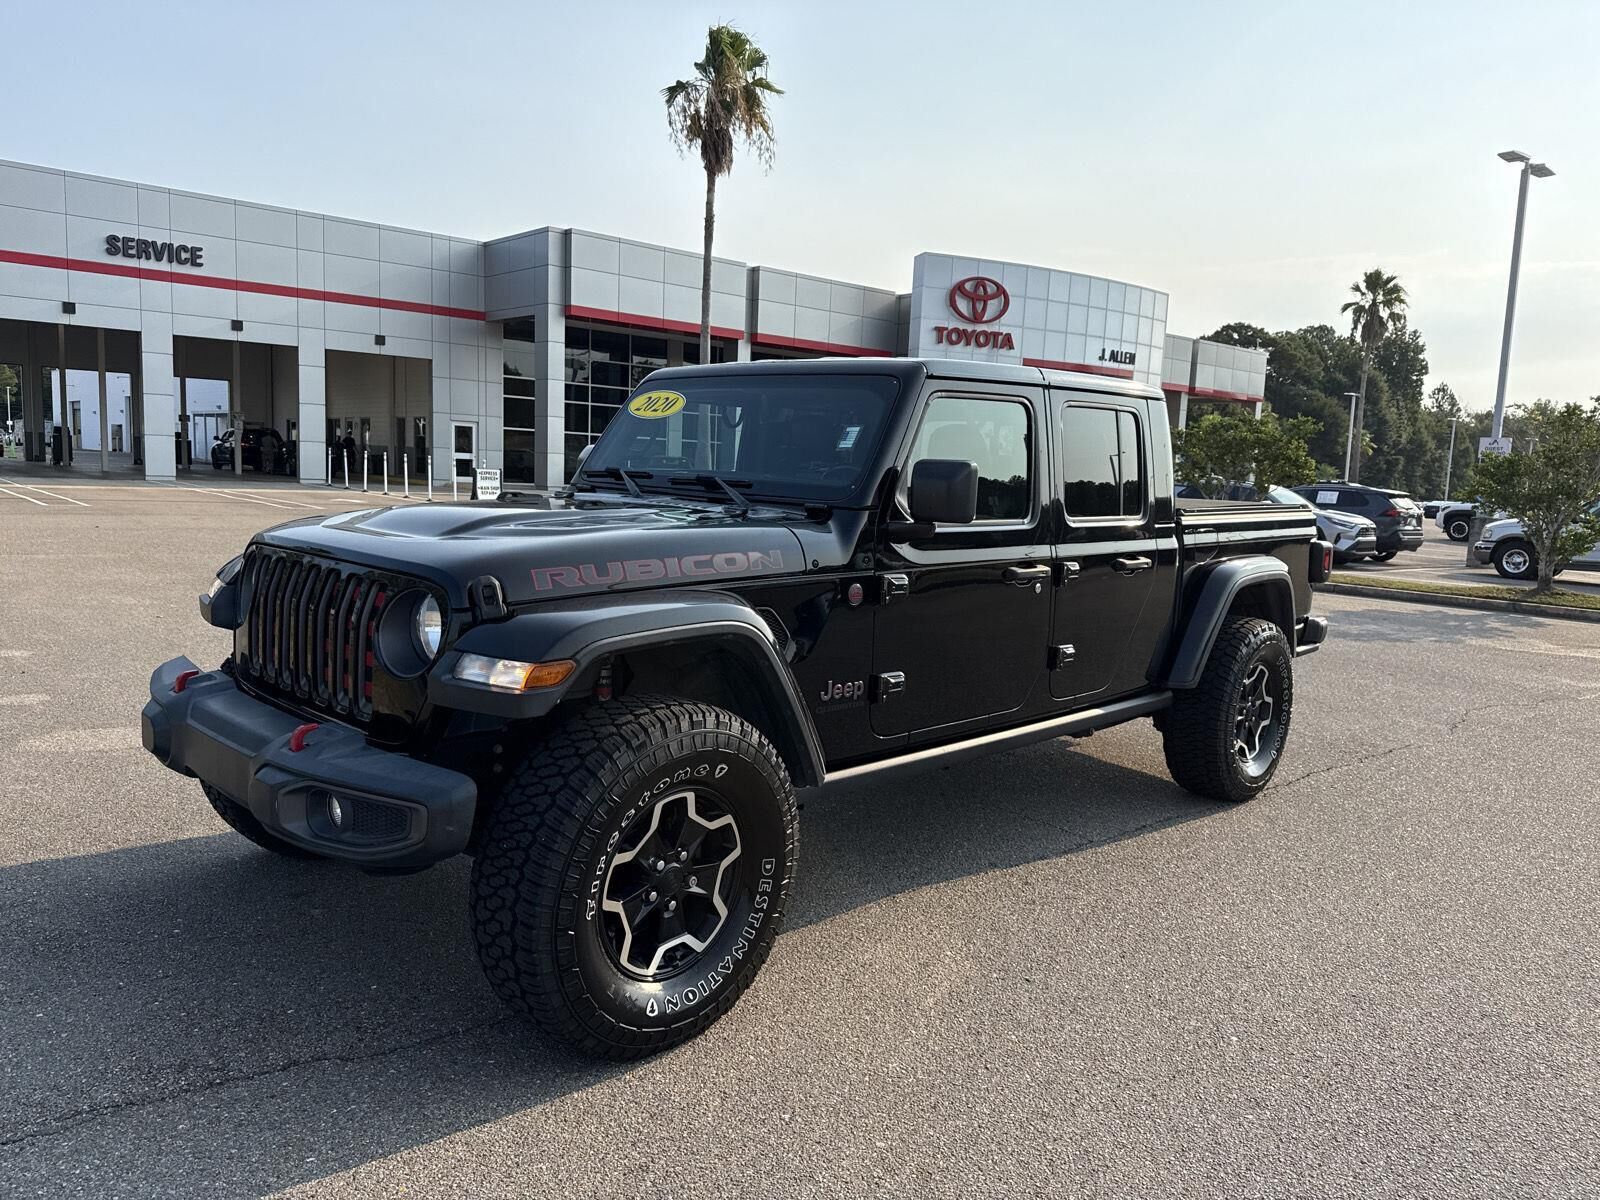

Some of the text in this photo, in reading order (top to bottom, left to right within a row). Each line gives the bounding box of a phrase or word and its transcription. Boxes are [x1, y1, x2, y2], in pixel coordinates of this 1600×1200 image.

[105, 234, 204, 267] SERVICE
[934, 326, 1015, 350] TOYOTA
[1108, 349, 1136, 365] ALLEN
[633, 396, 680, 412] 2020
[530, 549, 784, 591] RUBICON
[820, 680, 865, 701] Jeep
[664, 858, 776, 1013] DESTINATION
